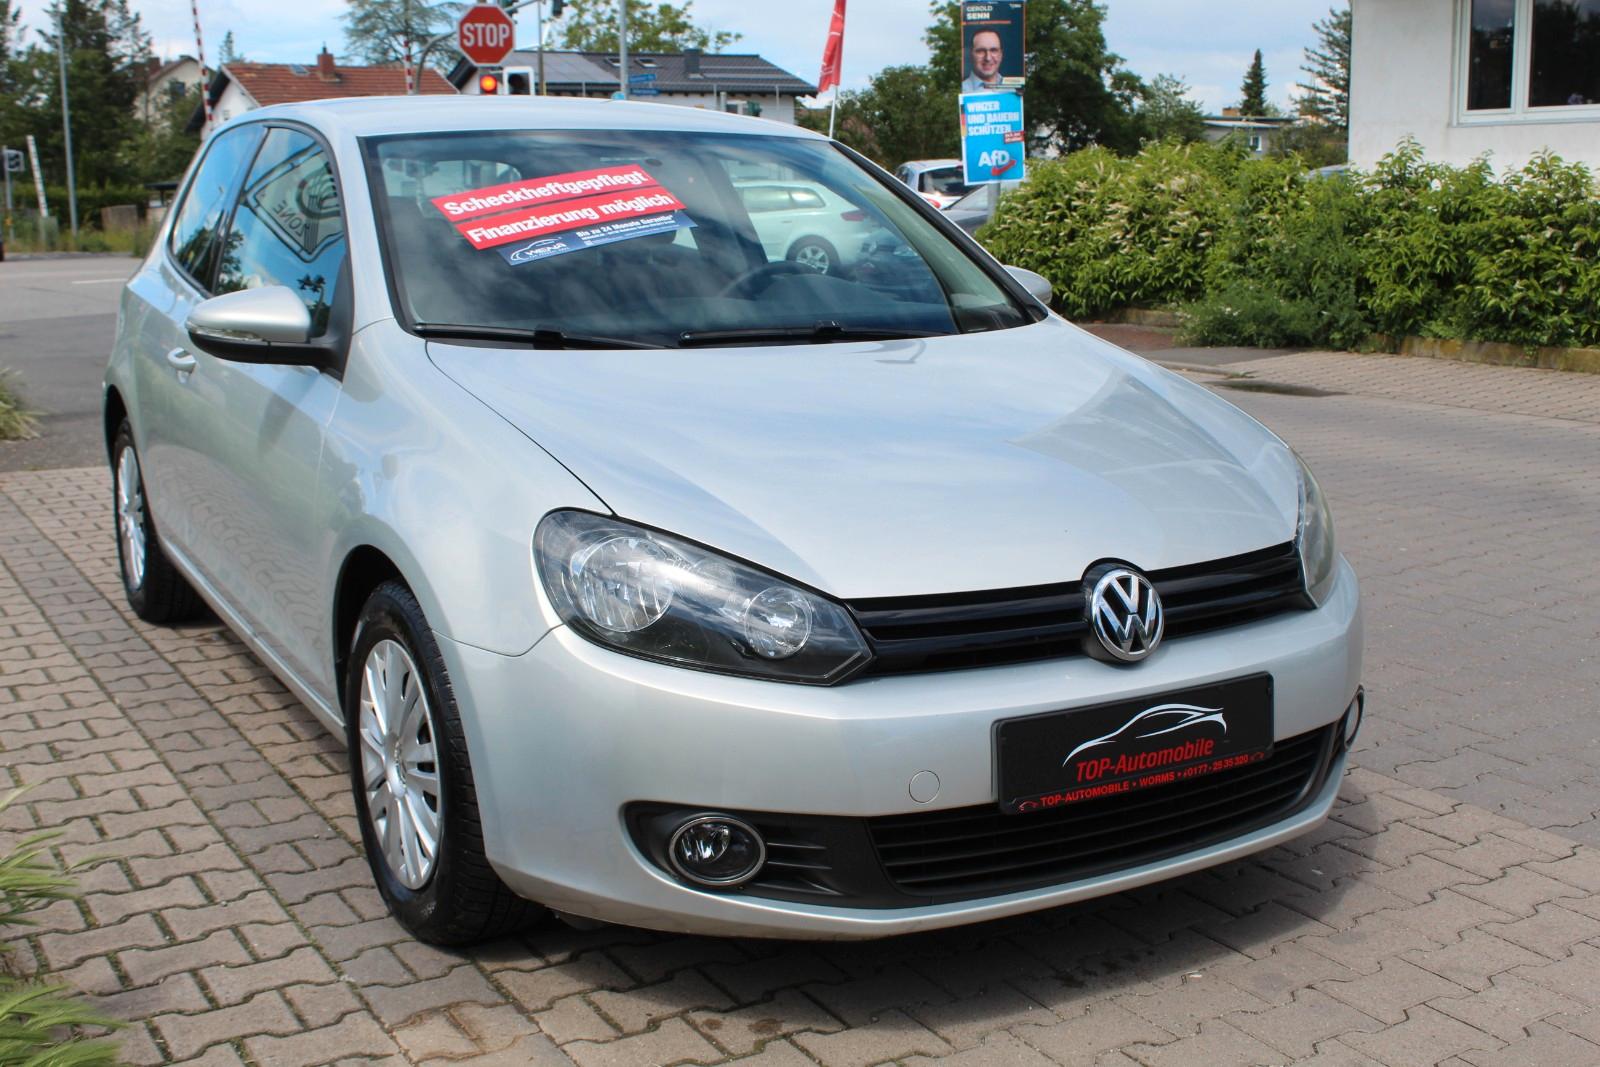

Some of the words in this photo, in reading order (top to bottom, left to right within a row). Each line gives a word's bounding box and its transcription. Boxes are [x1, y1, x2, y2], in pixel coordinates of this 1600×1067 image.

[462, 22, 510, 48] STOP
[978, 149, 1010, 167] AfD
[443, 170, 648, 216] Scheckheftgepflegt
[467, 206, 598, 243] Finanzierung
[600, 192, 675, 217] möglich
[1075, 738, 1215, 783] TOP-Automobile
[1040, 781, 1130, 808] TOP-AUTOMOBILE
[1139, 771, 1176, 787] WORMS
